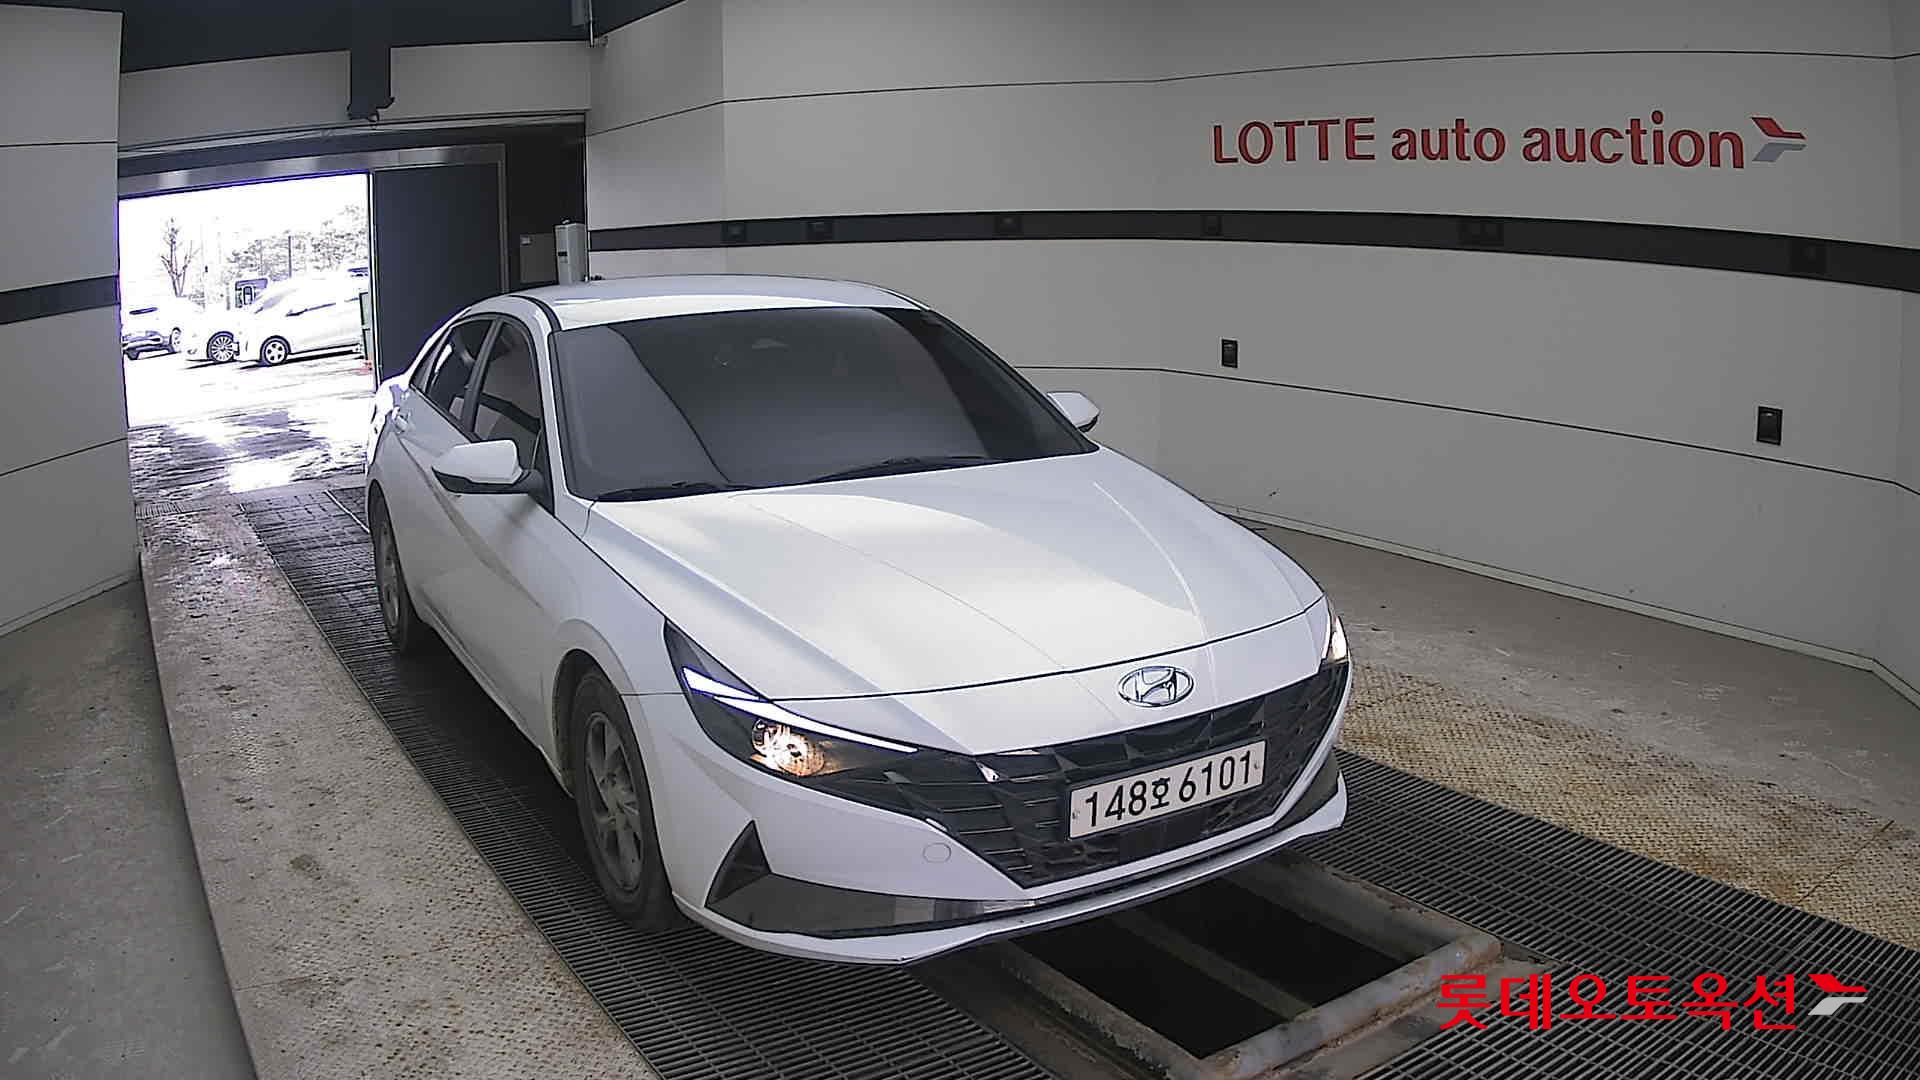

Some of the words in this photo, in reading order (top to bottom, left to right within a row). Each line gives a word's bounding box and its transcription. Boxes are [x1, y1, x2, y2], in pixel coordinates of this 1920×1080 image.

[1213, 117, 1376, 165] LOTTE
[1391, 118, 1506, 161] auto
[1522, 110, 1744, 169] auction
[1085, 777, 1170, 827] 148호
[1178, 750, 1252, 802] 6101
